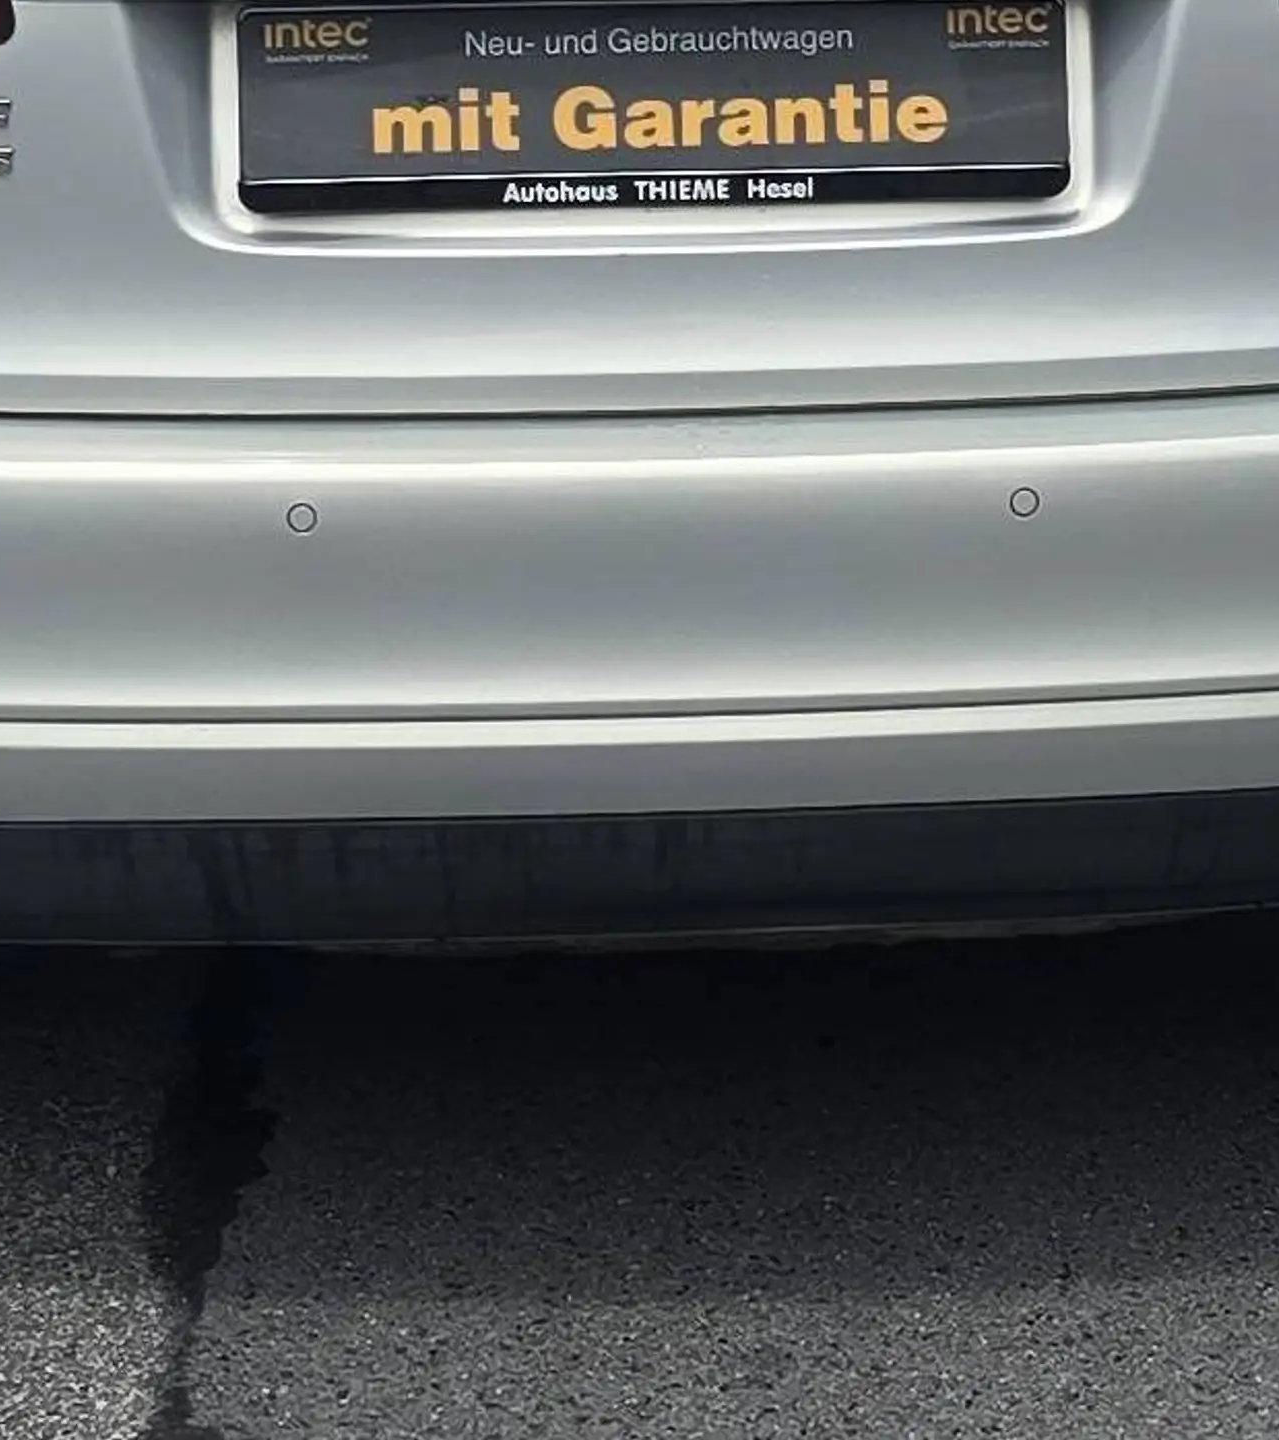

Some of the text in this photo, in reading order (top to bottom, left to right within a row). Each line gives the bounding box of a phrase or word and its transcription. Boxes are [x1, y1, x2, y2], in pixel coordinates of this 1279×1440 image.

[464, 25, 854, 57] Neu- und Gebrauchtwagen
[372, 79, 949, 153] mit Garantie
[503, 177, 814, 203] Autohaus THIEME Hesel
